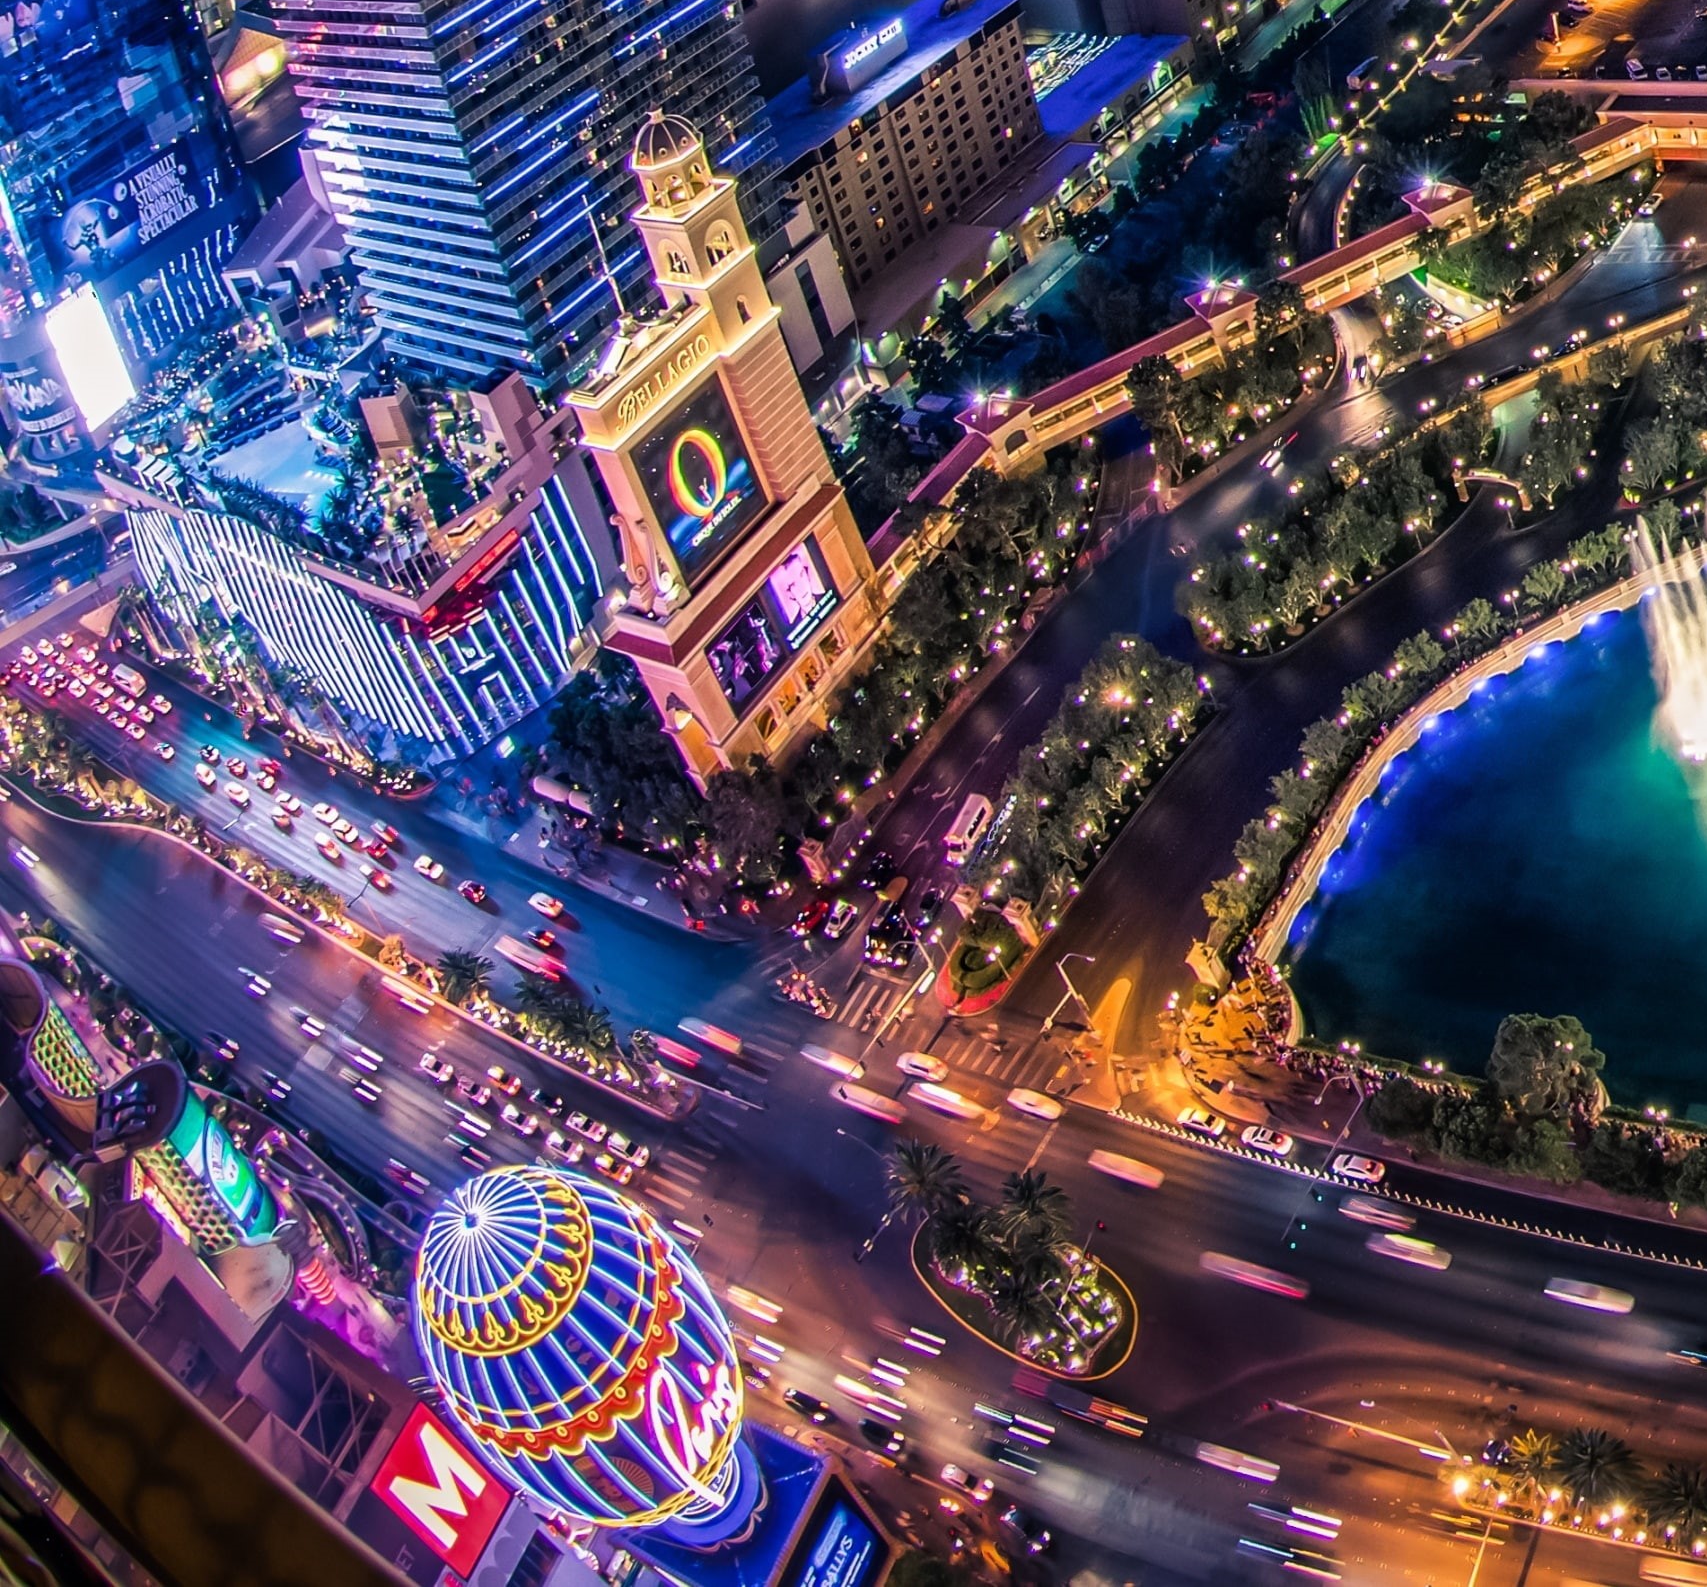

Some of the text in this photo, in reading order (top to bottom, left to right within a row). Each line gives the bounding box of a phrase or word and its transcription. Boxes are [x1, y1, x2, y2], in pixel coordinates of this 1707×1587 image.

[128, 152, 177, 197] A VISUALLY
[135, 171, 181, 209] STUNNING
[138, 195, 199, 245] SPECTACULAR
[139, 183, 188, 227] ACROBATIC
[616, 334, 710, 432] BELLAGIO
[668, 430, 727, 518] O
[692, 522, 715, 546] CIRQUE
[651, 1364, 737, 1507] Paris
[389, 1422, 487, 1549] M
